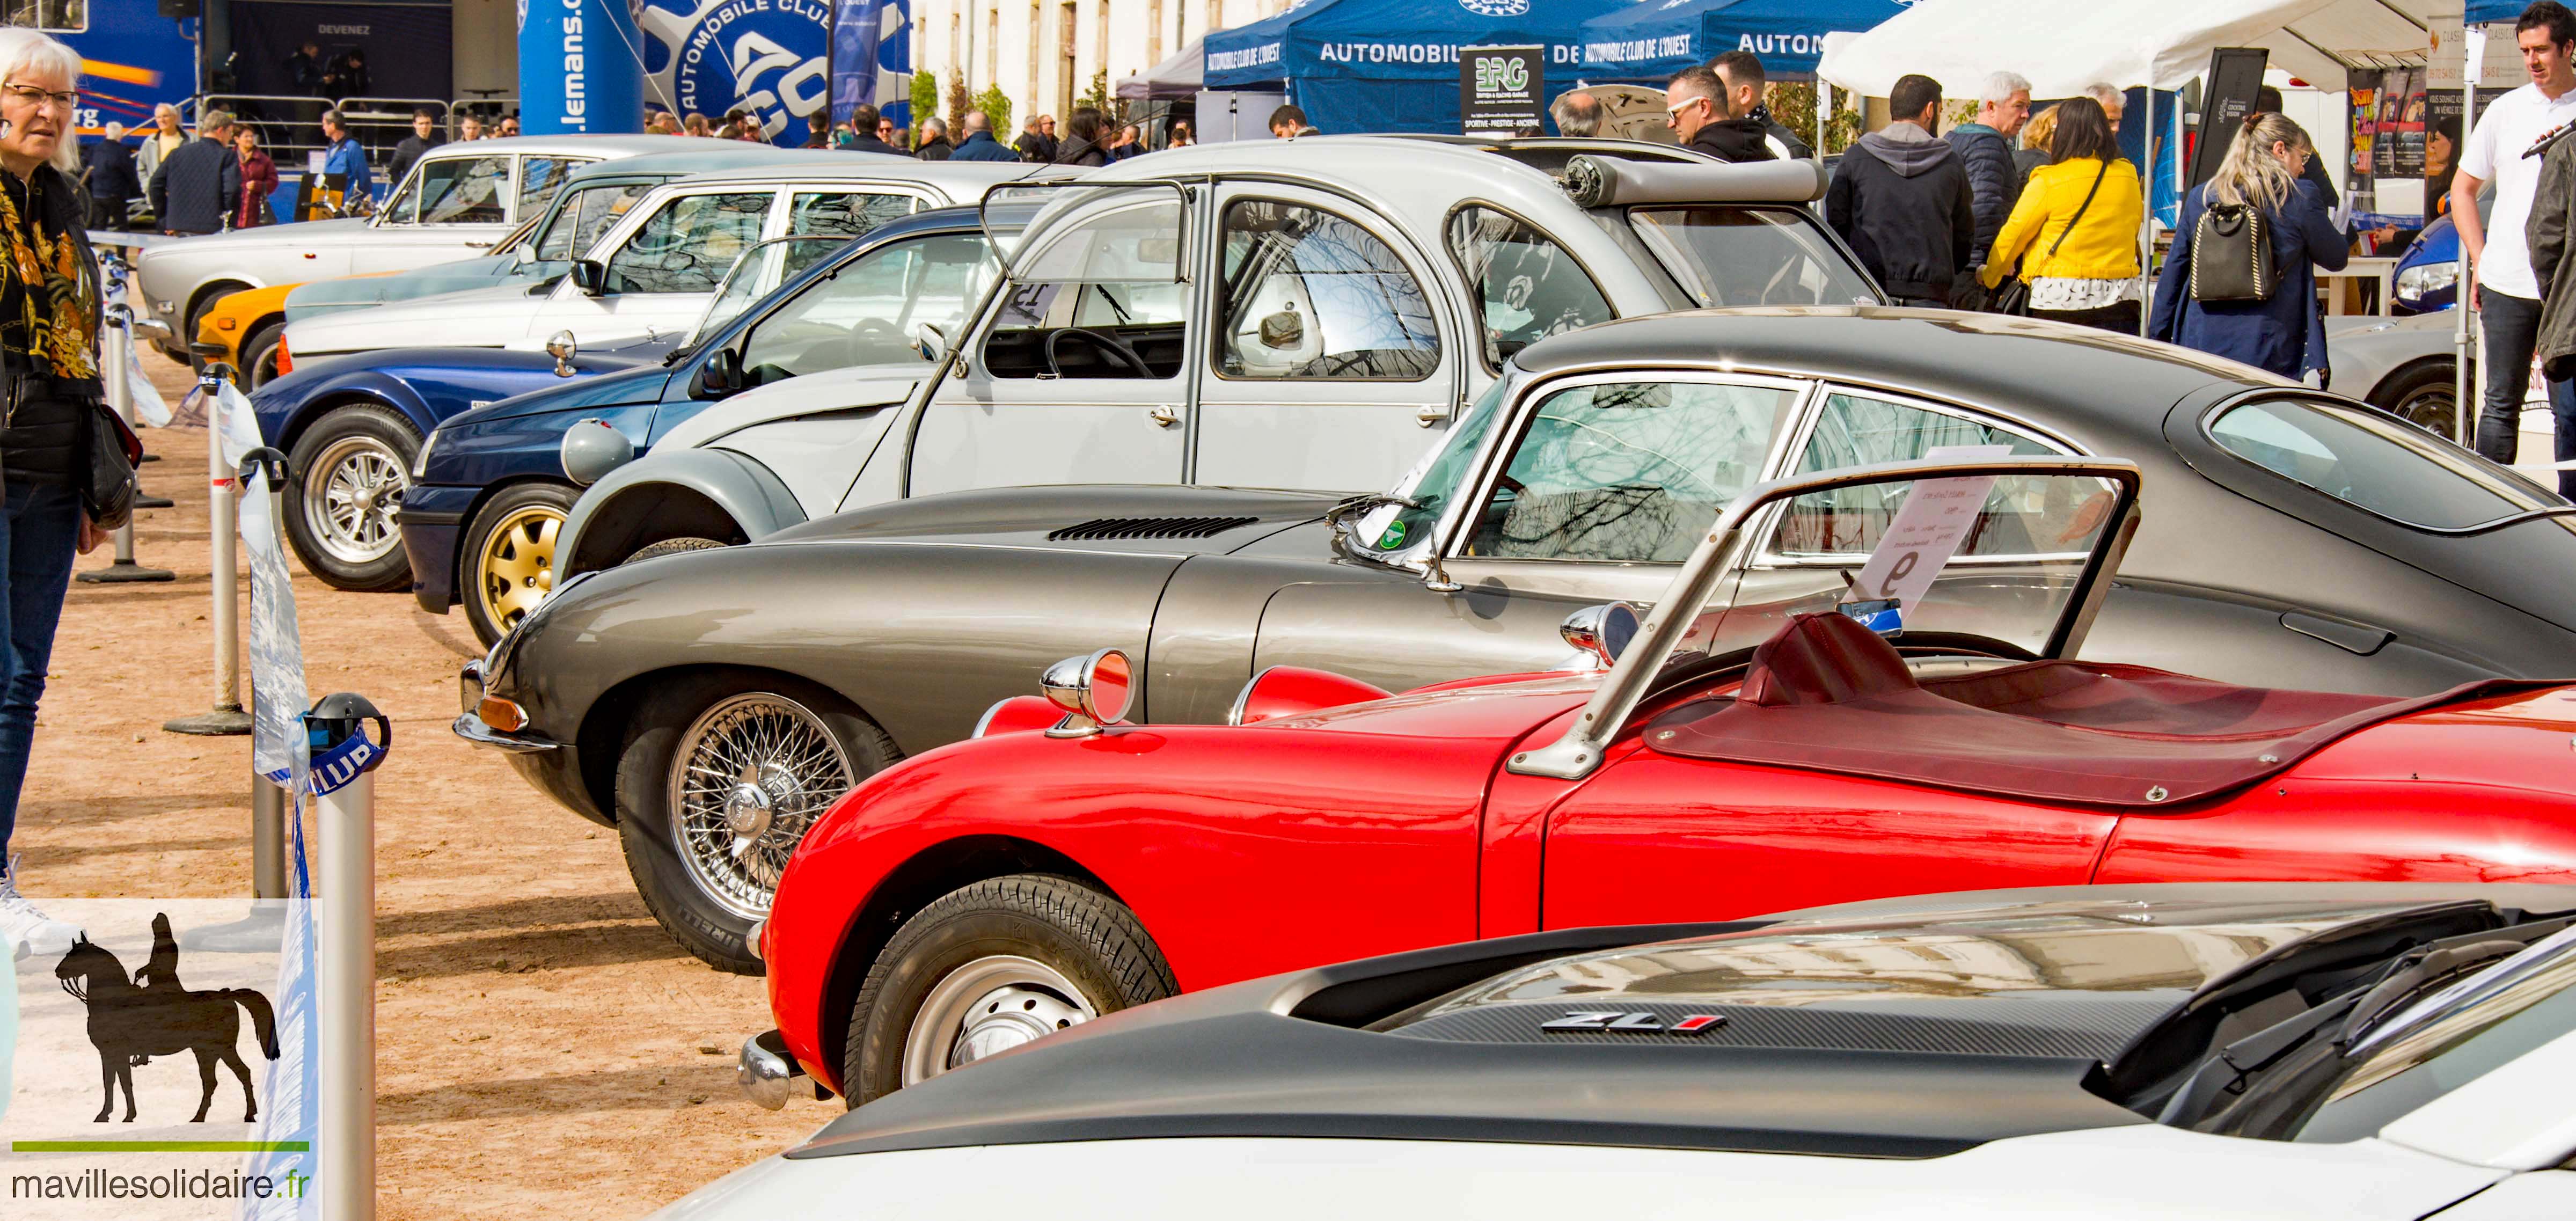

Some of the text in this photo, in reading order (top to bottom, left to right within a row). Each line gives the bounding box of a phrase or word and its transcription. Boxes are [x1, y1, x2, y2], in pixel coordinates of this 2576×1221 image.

[318, 25, 370, 35] DEVENEZ
[682, 0, 770, 108] AUTOMOBILE
[1208, 51, 1238, 71] AUTOMOBILE
[1237, 49, 1250, 68] CLUB
[1250, 47, 1258, 66] DE
[1320, 43, 1460, 63] AUTOMOBIL
[1585, 34, 1690, 62] AUTOMOBILE CLUB DE L'OUEST
[1465, 120, 1489, 128] SPORTIVE
[1491, 119, 1514, 127] PRESTIGE
